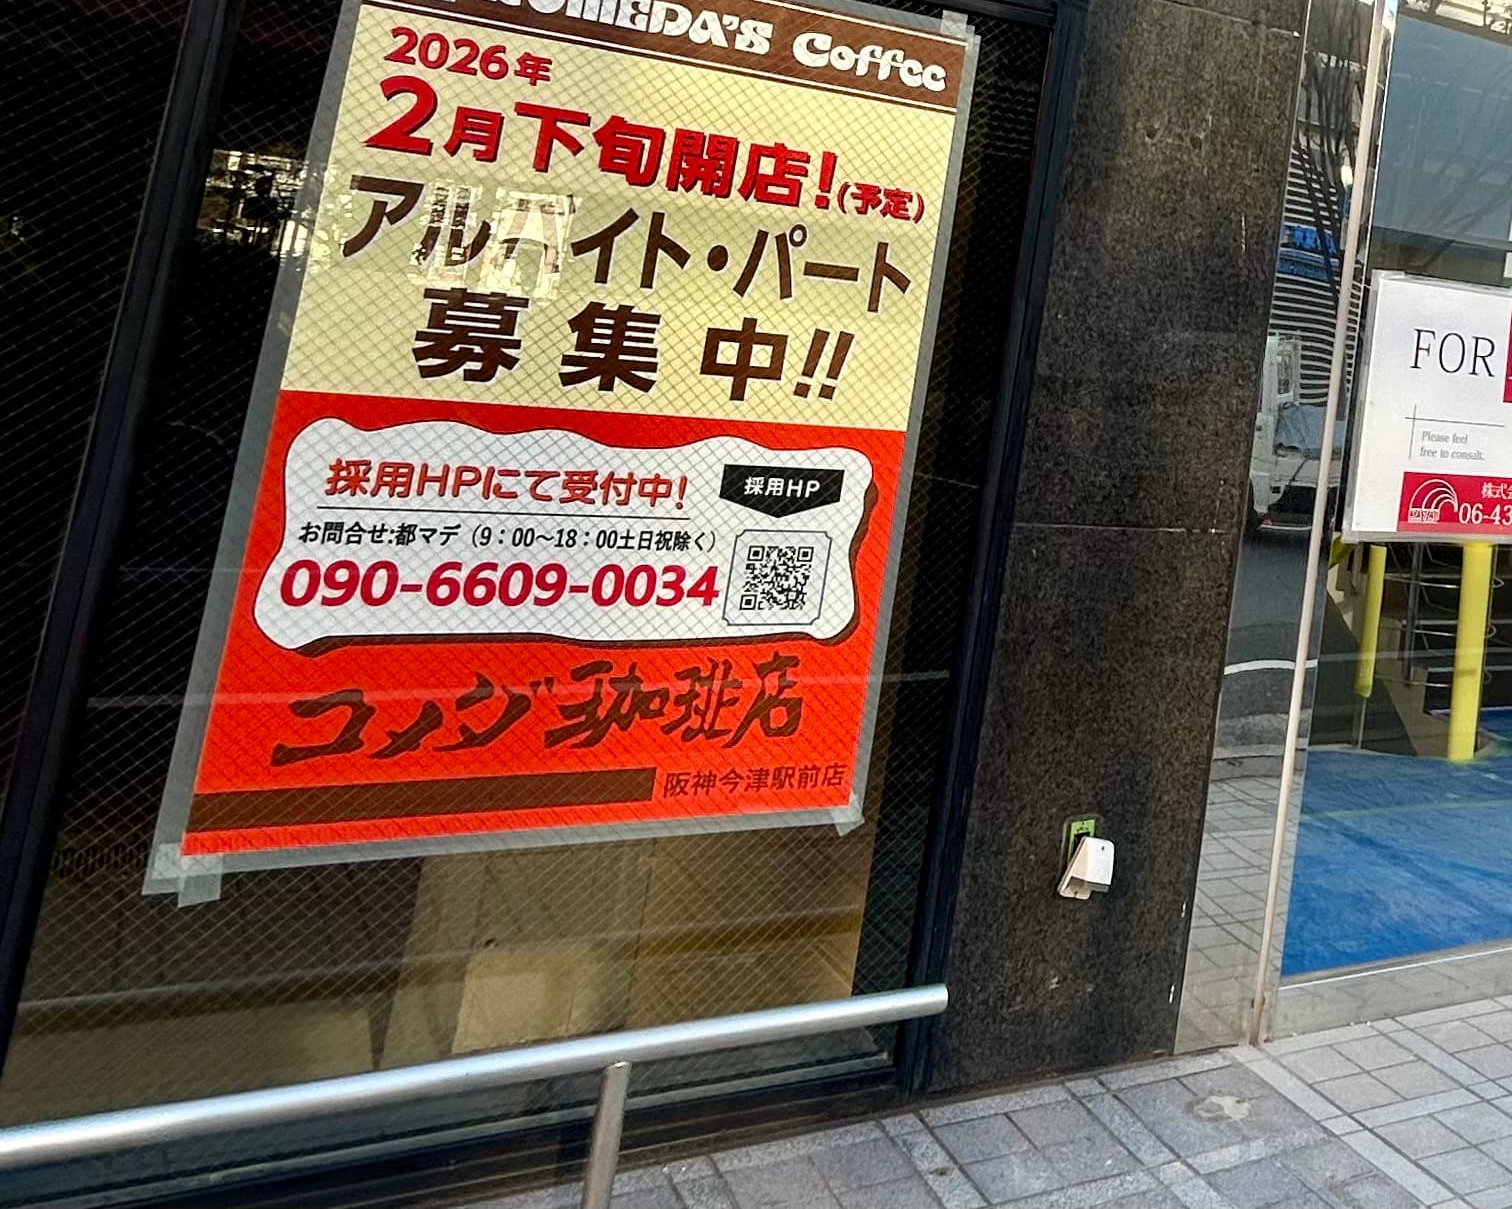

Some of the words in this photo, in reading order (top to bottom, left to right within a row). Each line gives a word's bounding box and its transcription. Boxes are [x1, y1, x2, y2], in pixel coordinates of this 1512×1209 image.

[383, 25, 554, 87] 2026年
[792, 30, 948, 93] Coffee
[1410, 328, 1497, 378] FOR
[1419, 446, 1438, 458] free
[1440, 448, 1449, 459] to
[1421, 430, 1450, 443] Please
[1452, 433, 1468, 445] feel
[325, 457, 689, 512] 採用HPにて受付中!
[743, 474, 822, 499] 採用HP
[279, 557, 721, 610] 090-6609-0034
[662, 763, 848, 799] 阪神今津駅前店
